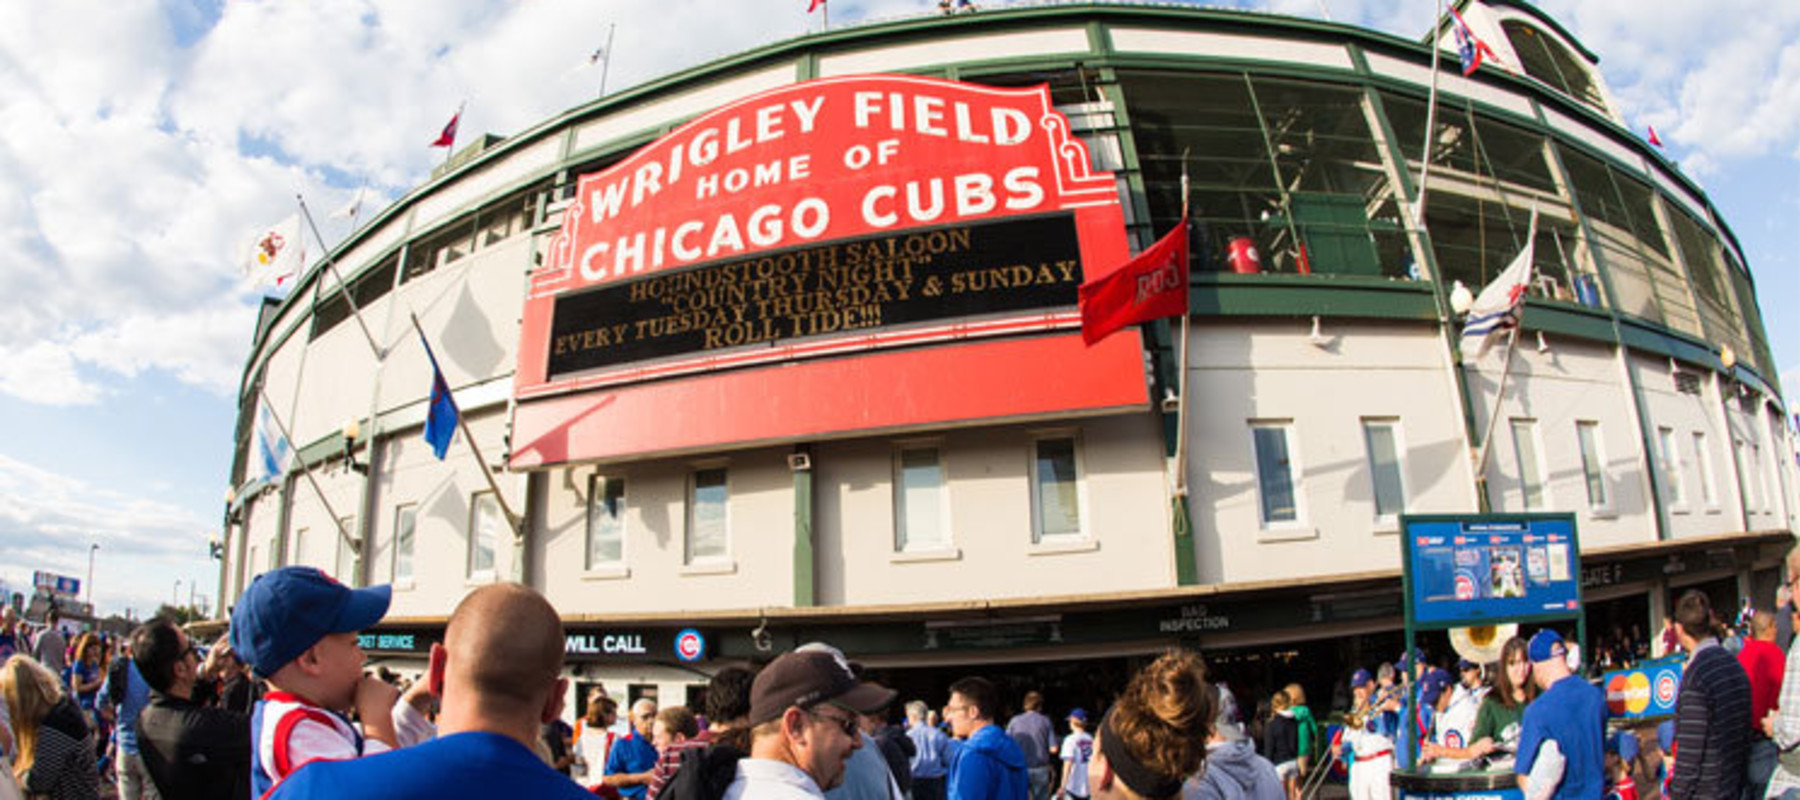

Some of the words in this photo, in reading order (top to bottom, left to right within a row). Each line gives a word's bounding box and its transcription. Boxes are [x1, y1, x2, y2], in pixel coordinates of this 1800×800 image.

[591, 96, 825, 223] WRIGLEY
[855, 91, 1032, 146] FIELD
[696, 154, 812, 199] HOME
[844, 138, 900, 170] OF
[579, 197, 830, 281] CHICAGO
[861, 166, 1045, 228] CUBS
[846, 228, 971, 265] SALOON
[556, 321, 629, 355] EVERY
[635, 302, 749, 340] TUESDAY
[758, 277, 913, 321] THURSDAY
[922, 274, 944, 297] &
[951, 259, 1077, 294] SUNDAY
[704, 317, 780, 349] ROLL
[790, 302, 882, 336] TIDE!!!
[378, 634, 415, 648] SERVICE
[564, 635, 600, 653] WILL
[603, 635, 647, 653] CALL
[1159, 615, 1229, 632] INSPECTION
